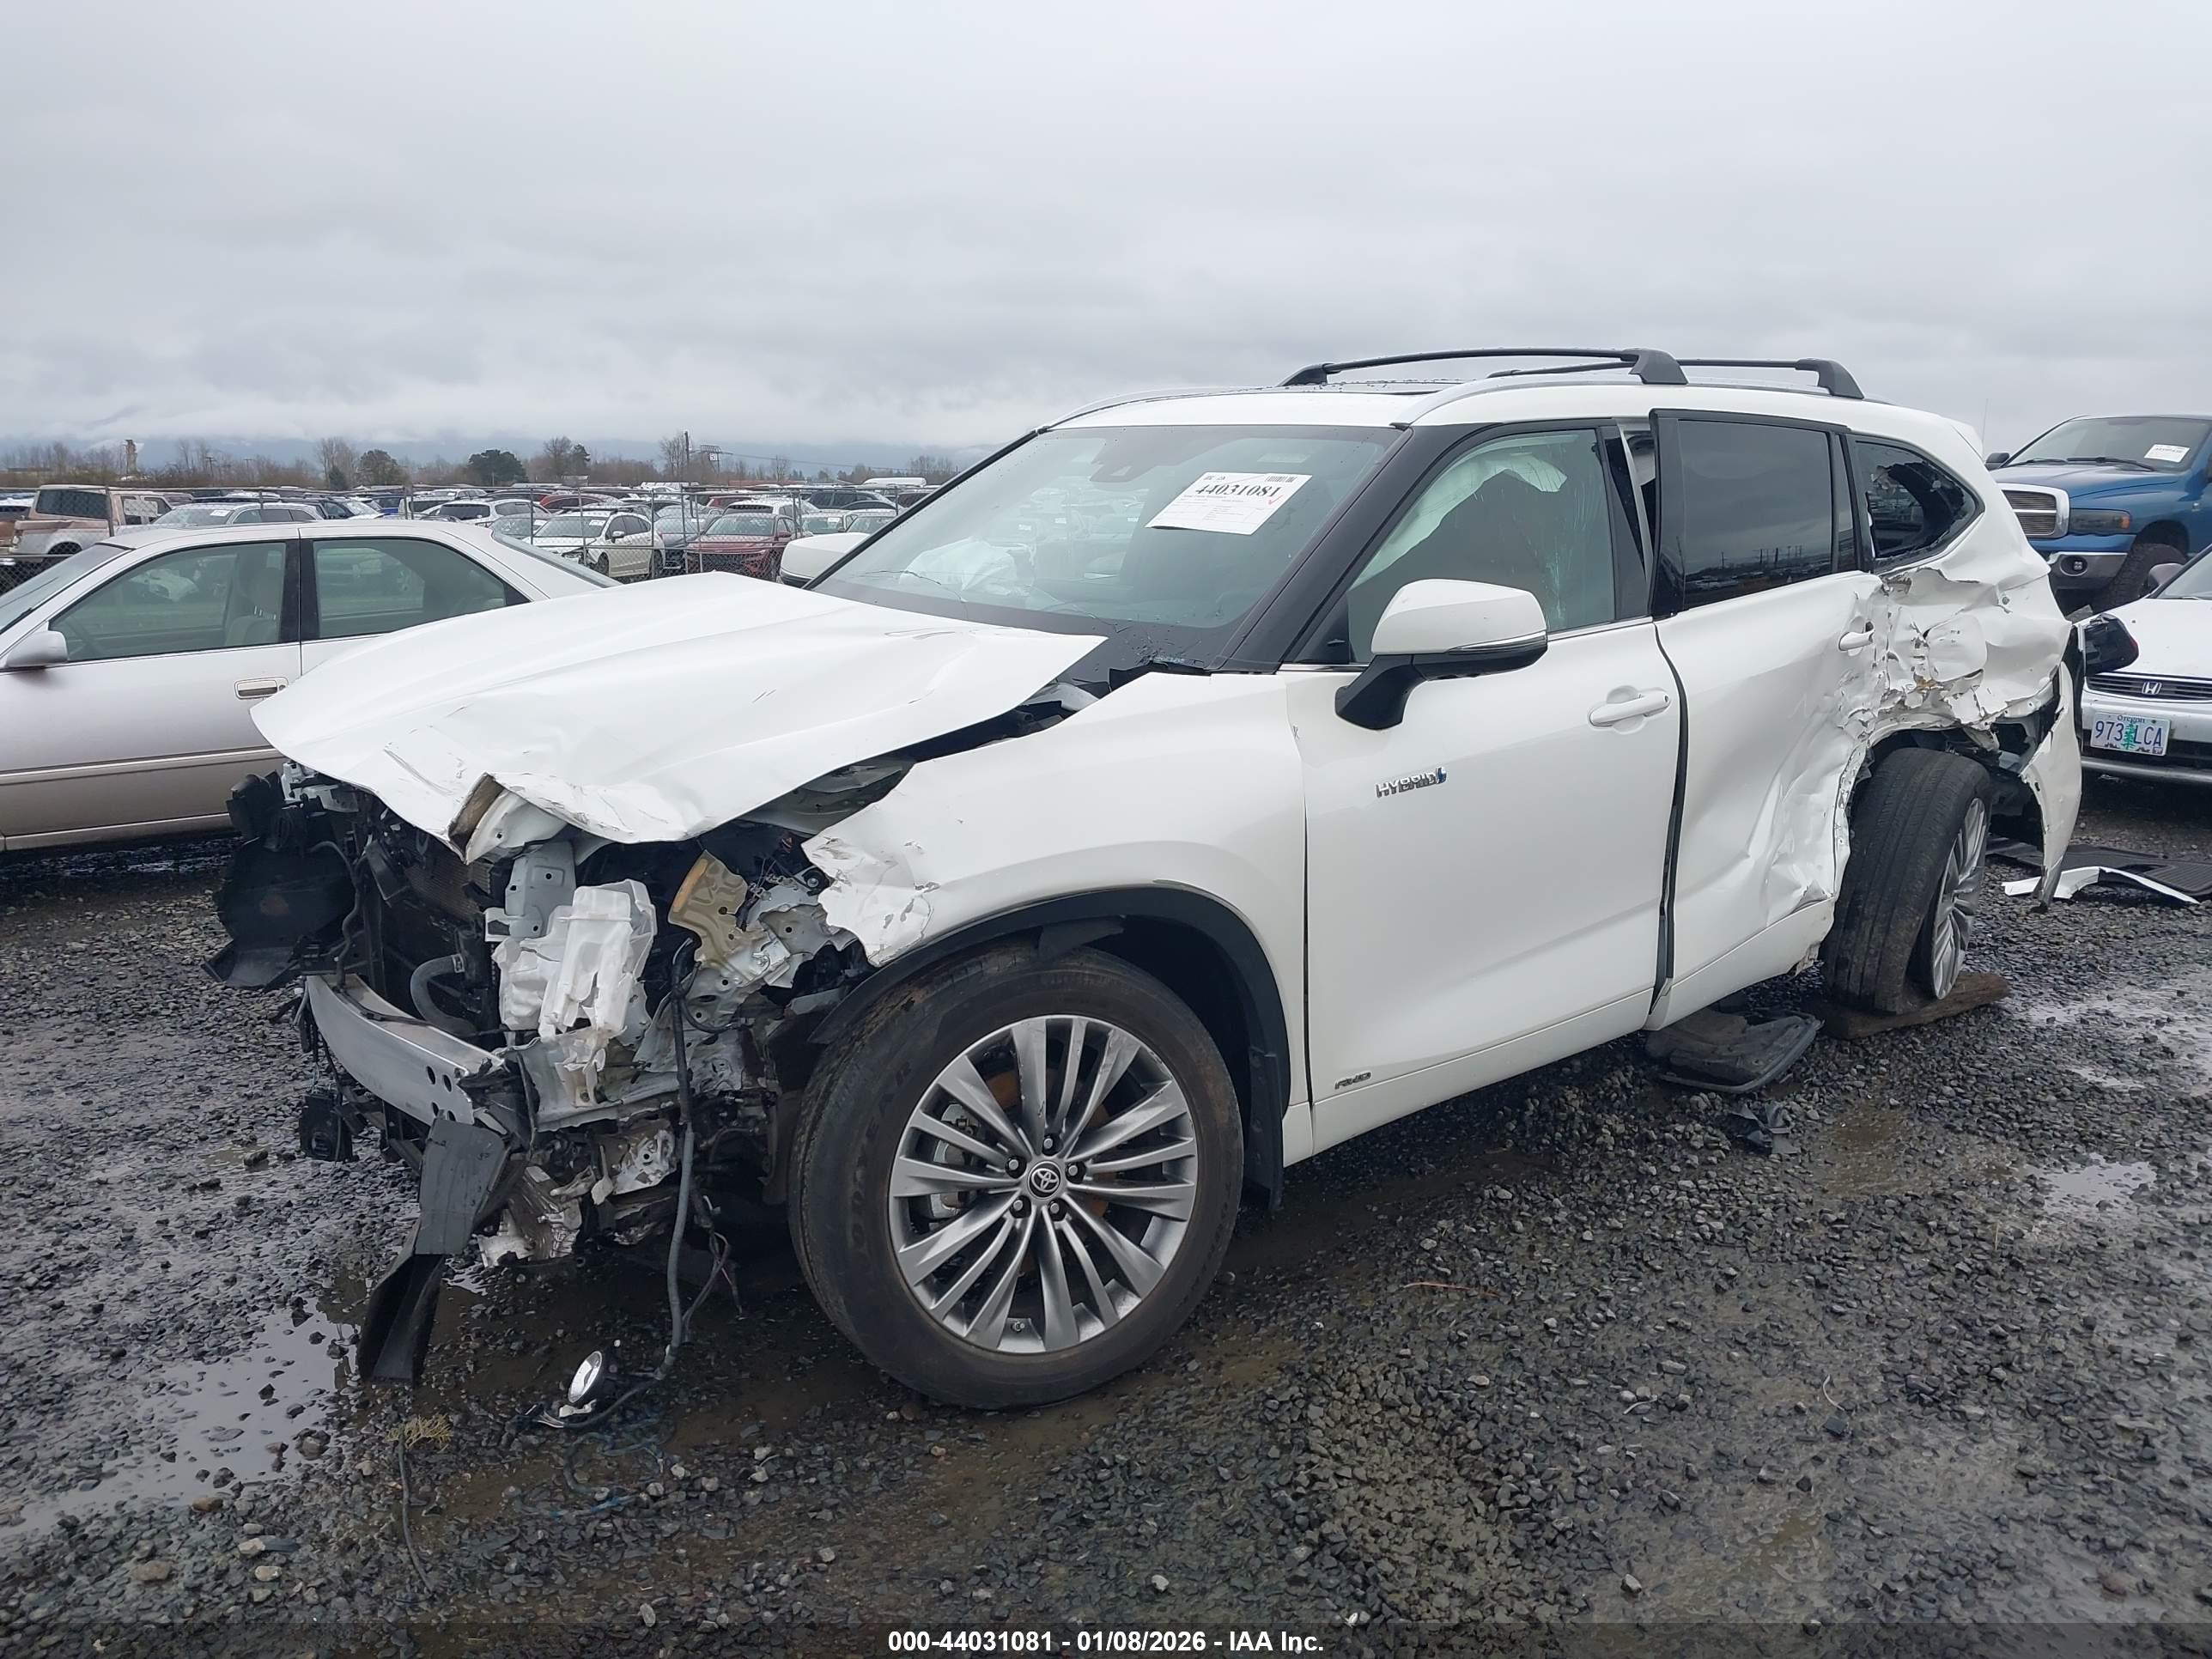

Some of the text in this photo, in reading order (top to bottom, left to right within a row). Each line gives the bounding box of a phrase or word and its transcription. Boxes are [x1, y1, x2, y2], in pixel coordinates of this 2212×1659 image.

[1194, 483, 1282, 497] 44031081
[2118, 714, 2146, 725] Oregon
[2095, 720, 2162, 747] 973 LCA
